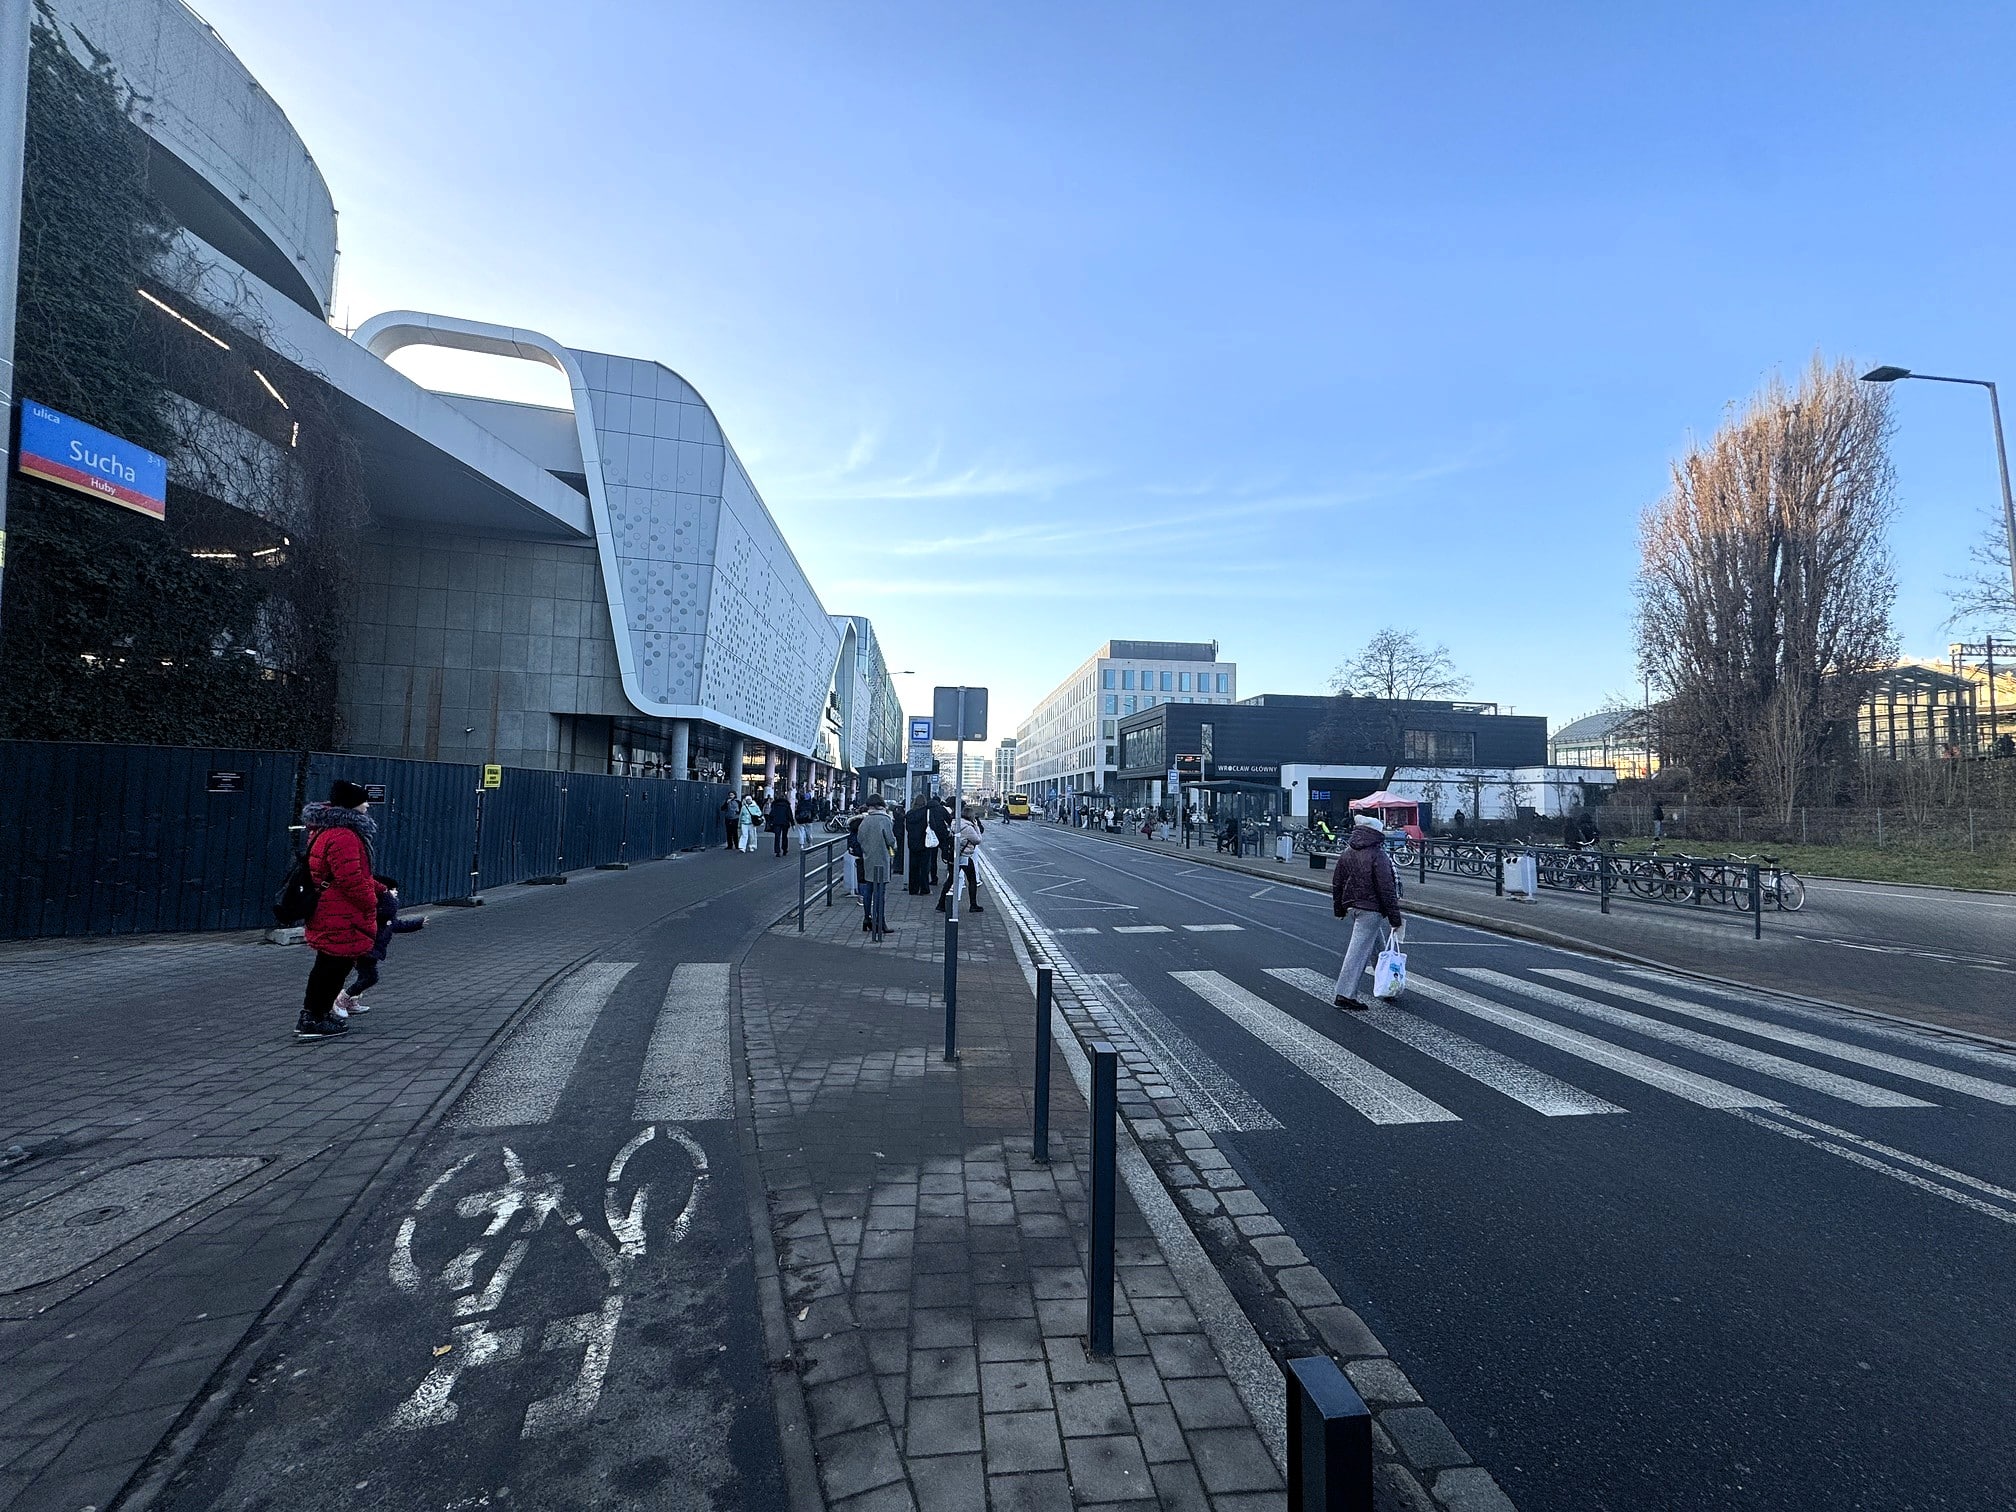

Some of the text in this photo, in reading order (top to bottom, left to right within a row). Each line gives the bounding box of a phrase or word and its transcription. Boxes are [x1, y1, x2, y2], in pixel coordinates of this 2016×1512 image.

[33, 406, 60, 424] ulica
[69, 440, 136, 483] Sucha
[90, 477, 117, 496] Huby
